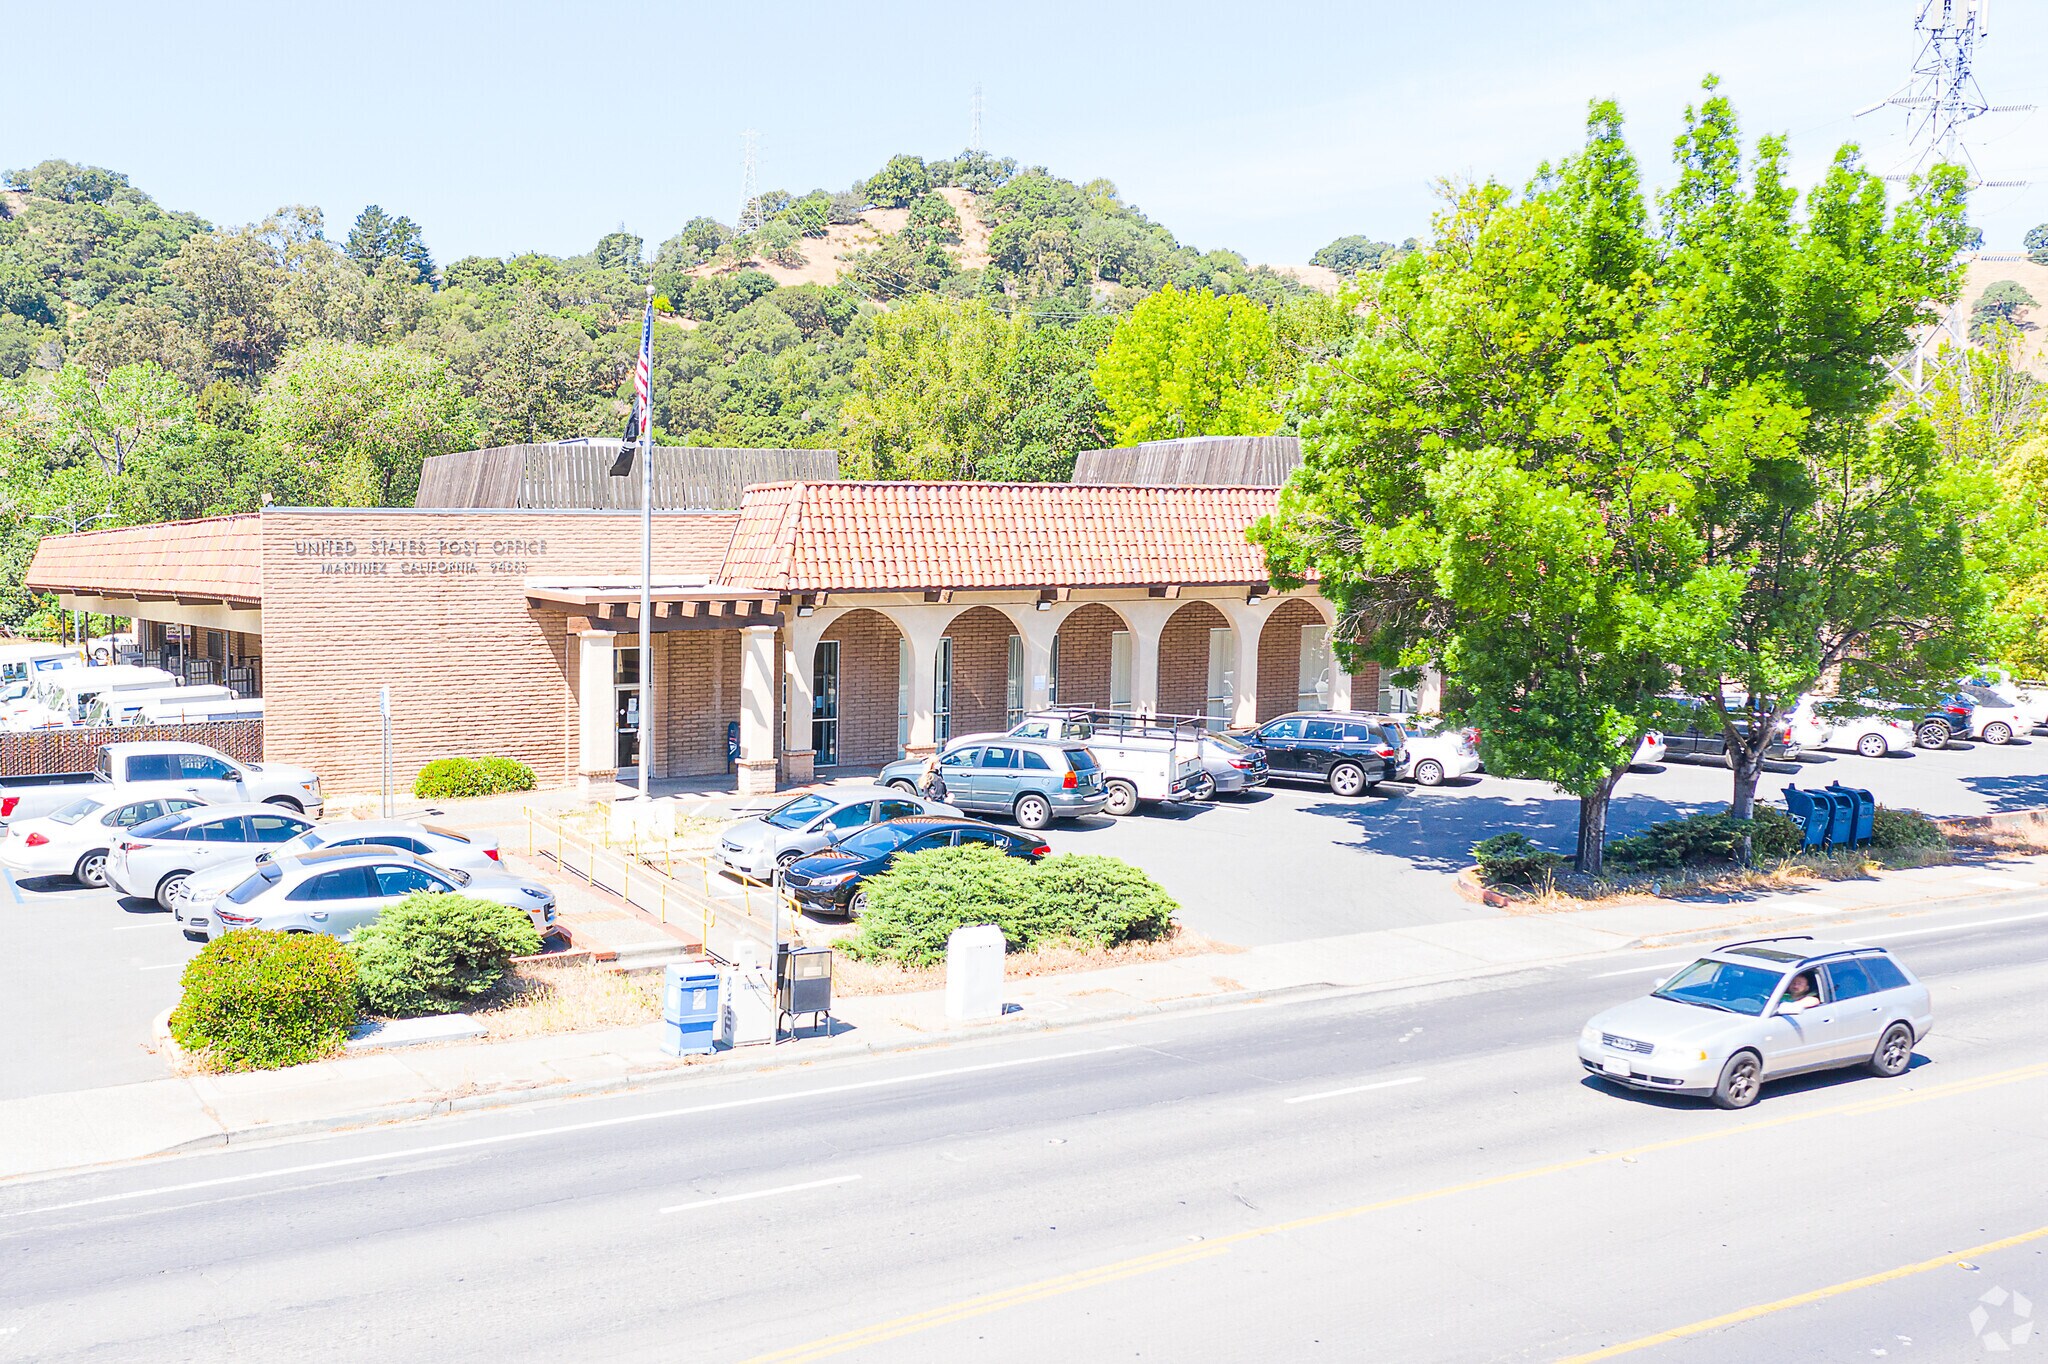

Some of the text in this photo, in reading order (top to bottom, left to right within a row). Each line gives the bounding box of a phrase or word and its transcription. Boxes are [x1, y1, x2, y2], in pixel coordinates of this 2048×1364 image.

[294, 539, 547, 556] UNITED STATES POST OFFICE
[321, 561, 387, 575] MARTINEZ
[400, 561, 479, 575] CALIFORNIA
